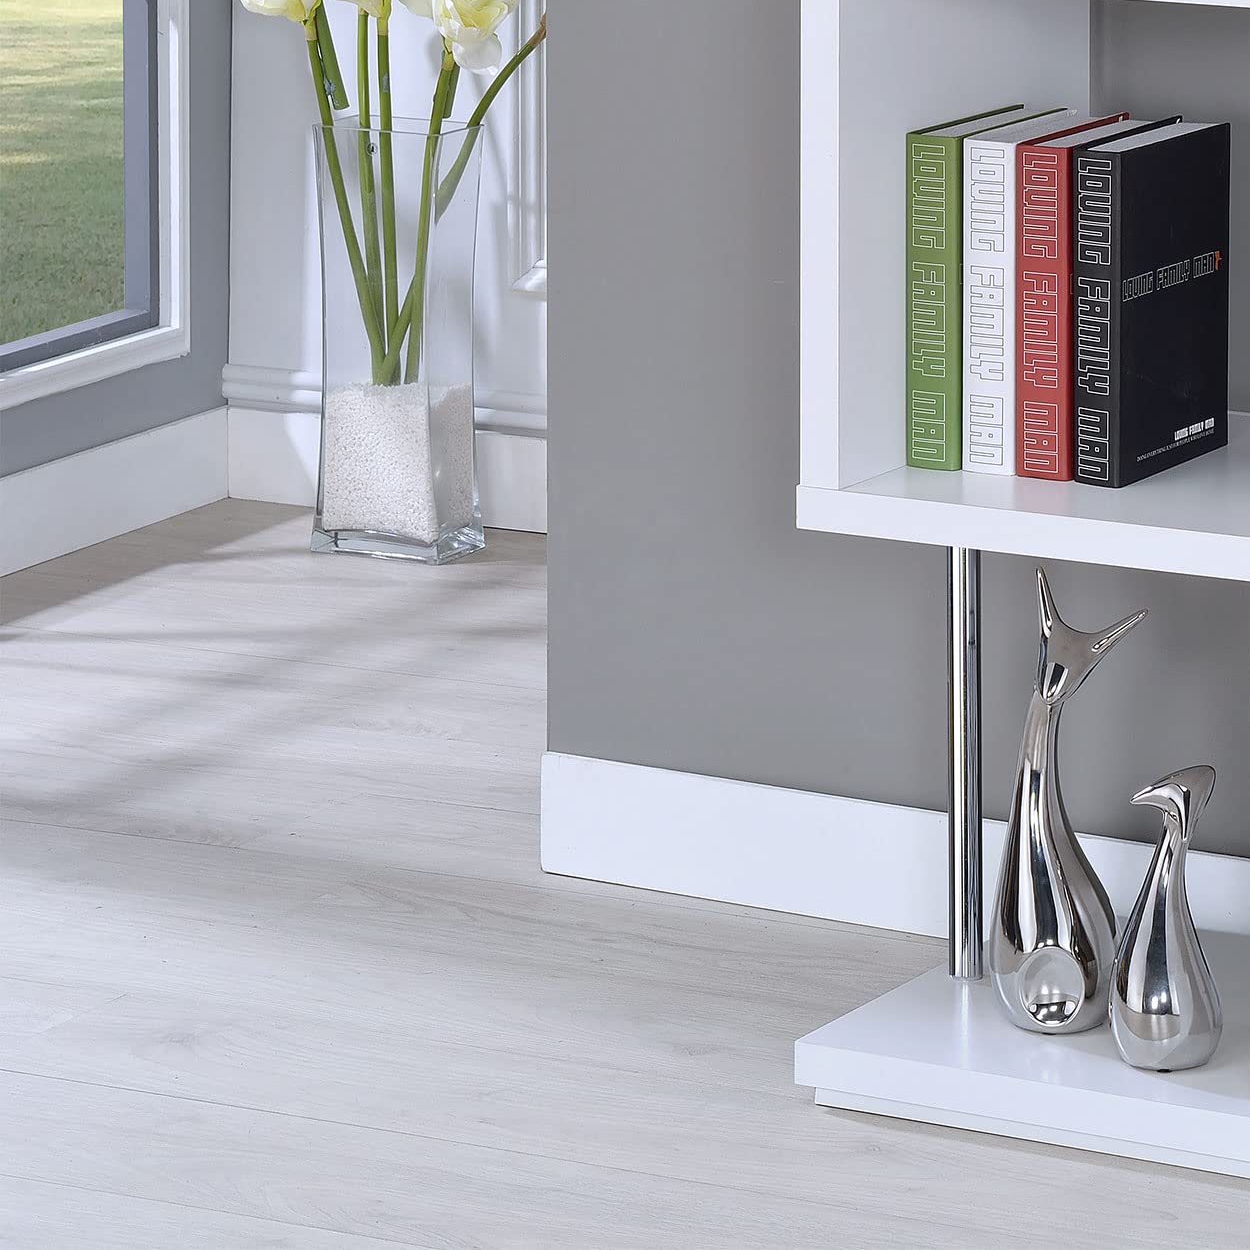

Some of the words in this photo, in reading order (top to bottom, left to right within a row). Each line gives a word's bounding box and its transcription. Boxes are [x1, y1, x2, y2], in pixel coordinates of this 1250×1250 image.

[1156, 258, 1191, 291] FAMILY
[912, 261, 946, 378] FAMILY
[970, 265, 1005, 382] FAMILY
[1023, 271, 1058, 389] FAMILY
[1077, 276, 1111, 396] FAMILY
[912, 389, 946, 462] MAN
[969, 393, 1004, 466] MAN
[1023, 400, 1059, 474] MAN
[1077, 406, 1110, 481] MAN
